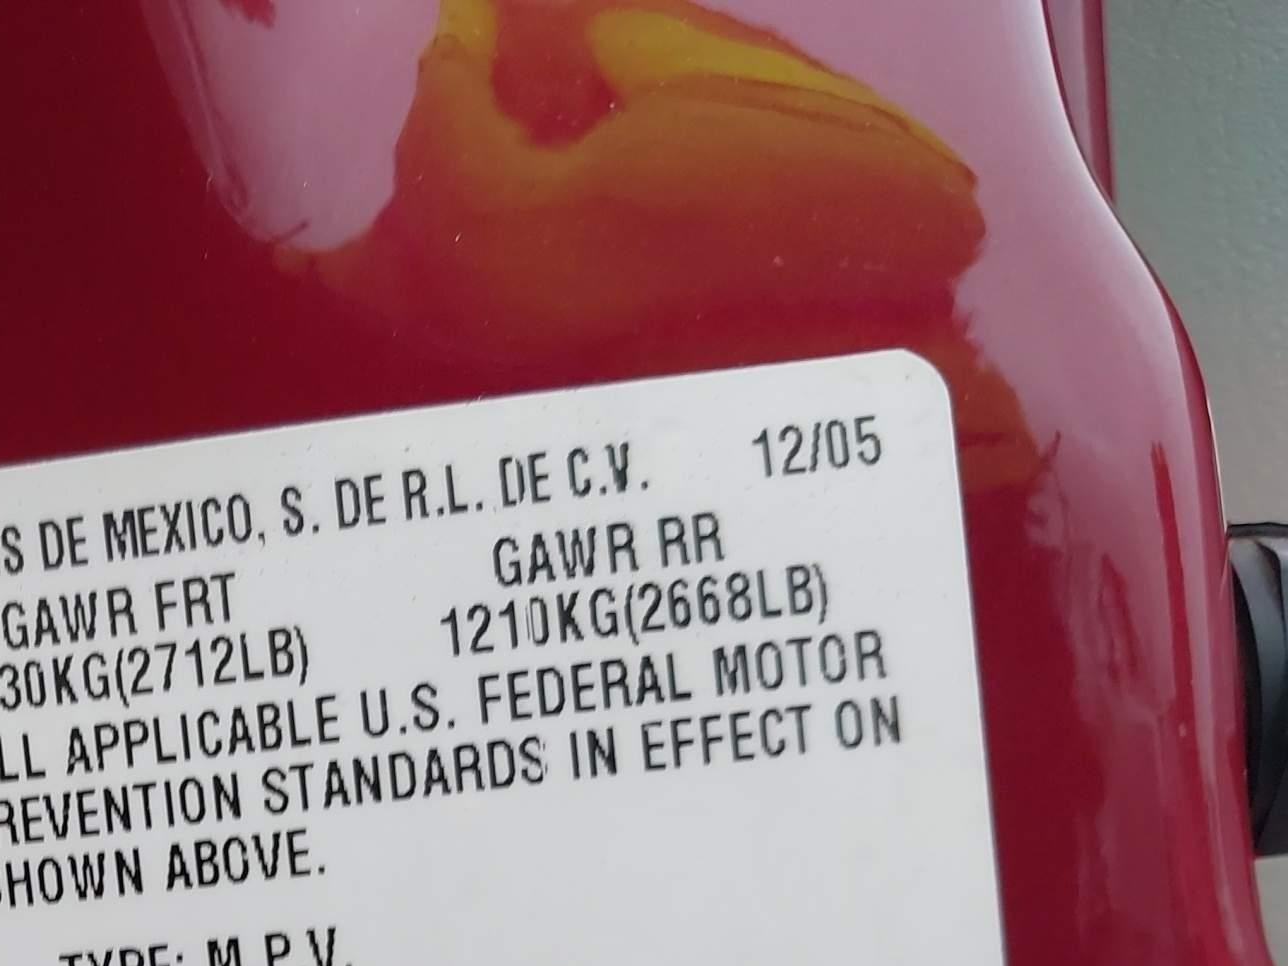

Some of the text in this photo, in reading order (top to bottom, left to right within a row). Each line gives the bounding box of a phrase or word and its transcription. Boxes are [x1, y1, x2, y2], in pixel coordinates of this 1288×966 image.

[751, 415, 882, 478] 12/05
[38, 515, 89, 572] DE
[102, 492, 266, 563] MEXICO,
[280, 485, 320, 537] S.
[334, 473, 387, 530] DE
[401, 463, 484, 521] R.L.
[498, 450, 552, 508] DE
[566, 441, 649, 498] C.V.
[492, 511, 725, 588] GAWR RR
[0, 571, 236, 651] GAWR FRT
[440, 563, 829, 657] 1210KG(2668LB)
[66, 693, 341, 776] APPLICABLE
[359, 681, 456, 739] U.S.
[477, 652, 693, 725] FEDERAL
[712, 629, 888, 697] MOTOR
[261, 735, 549, 816] STANDARDS
[569, 726, 618, 780] IN
[640, 703, 812, 772] EFFECT
[834, 695, 902, 750] ON
[165, 827, 326, 892] ABOVE.
